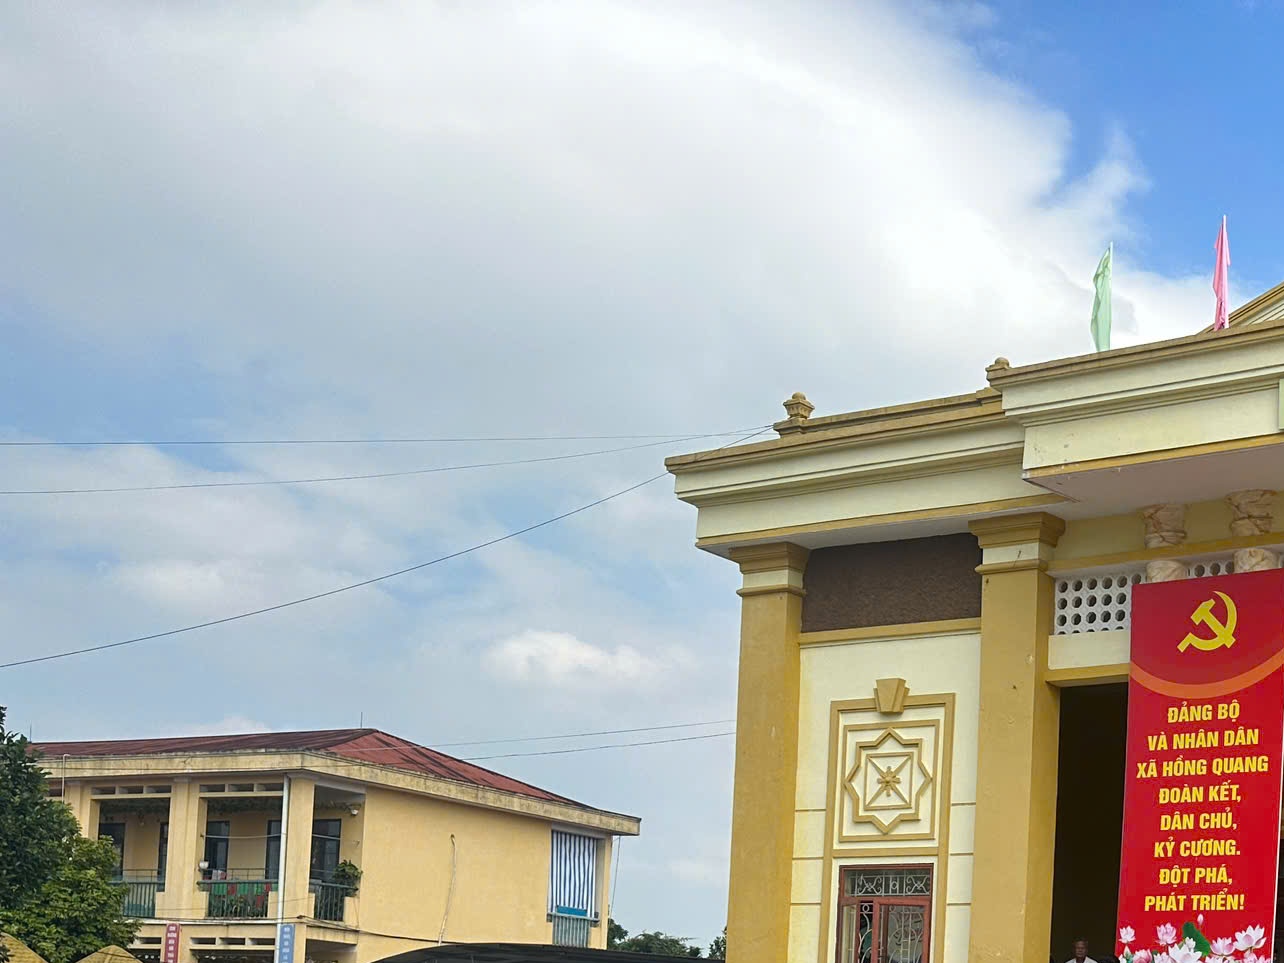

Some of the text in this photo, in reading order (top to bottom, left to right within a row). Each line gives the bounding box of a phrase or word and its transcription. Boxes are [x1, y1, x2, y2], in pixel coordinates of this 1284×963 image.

[1167, 699, 1240, 724] ĐẢNG BỘ
[1147, 726, 1259, 752] VÀ NHÂN DÂN
[1136, 754, 1269, 779] XÃ HỒNG QUANG
[1158, 779, 1241, 804] ĐOÀN KẾT,
[1160, 806, 1237, 831] DÂN CHỦ,
[1153, 836, 1241, 858] KỶ CƯƠNG.
[1159, 863, 1233, 888] ĐỘT PHÁ,
[1144, 887, 1245, 912] PHÁT TRIỂN!
